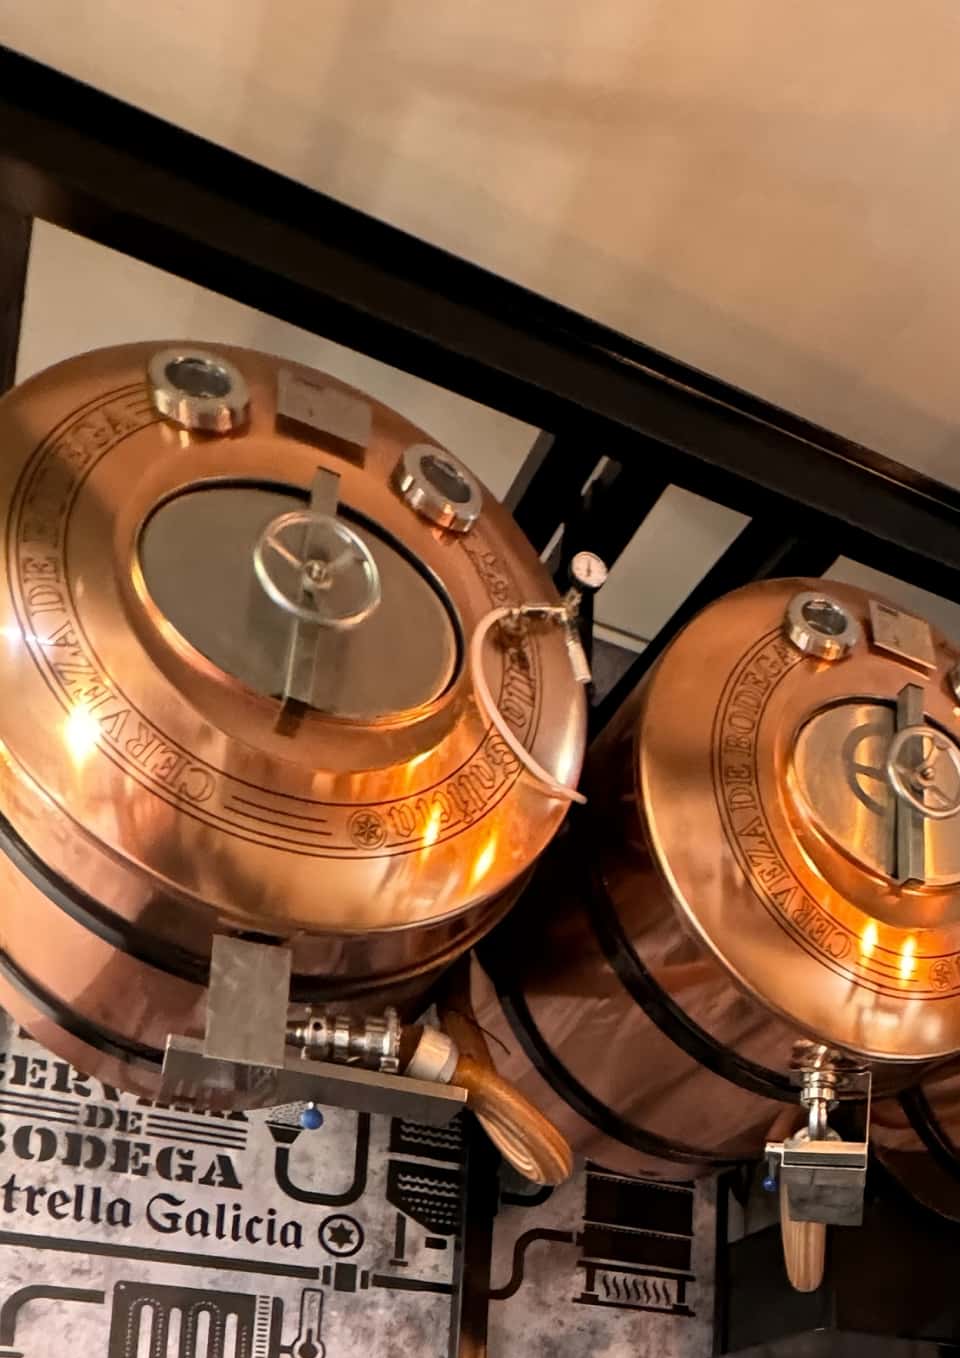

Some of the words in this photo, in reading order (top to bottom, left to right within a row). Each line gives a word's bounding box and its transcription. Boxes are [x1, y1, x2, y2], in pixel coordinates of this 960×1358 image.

[23, 556, 67, 616] DE
[46, 619, 217, 803] CERVEZA
[726, 638, 799, 751] BODEGA
[726, 765, 756, 811] DE
[739, 817, 852, 960] CERVEZA
[83, 1104, 143, 1135] DE
[146, 1193, 304, 1249] Galicia
